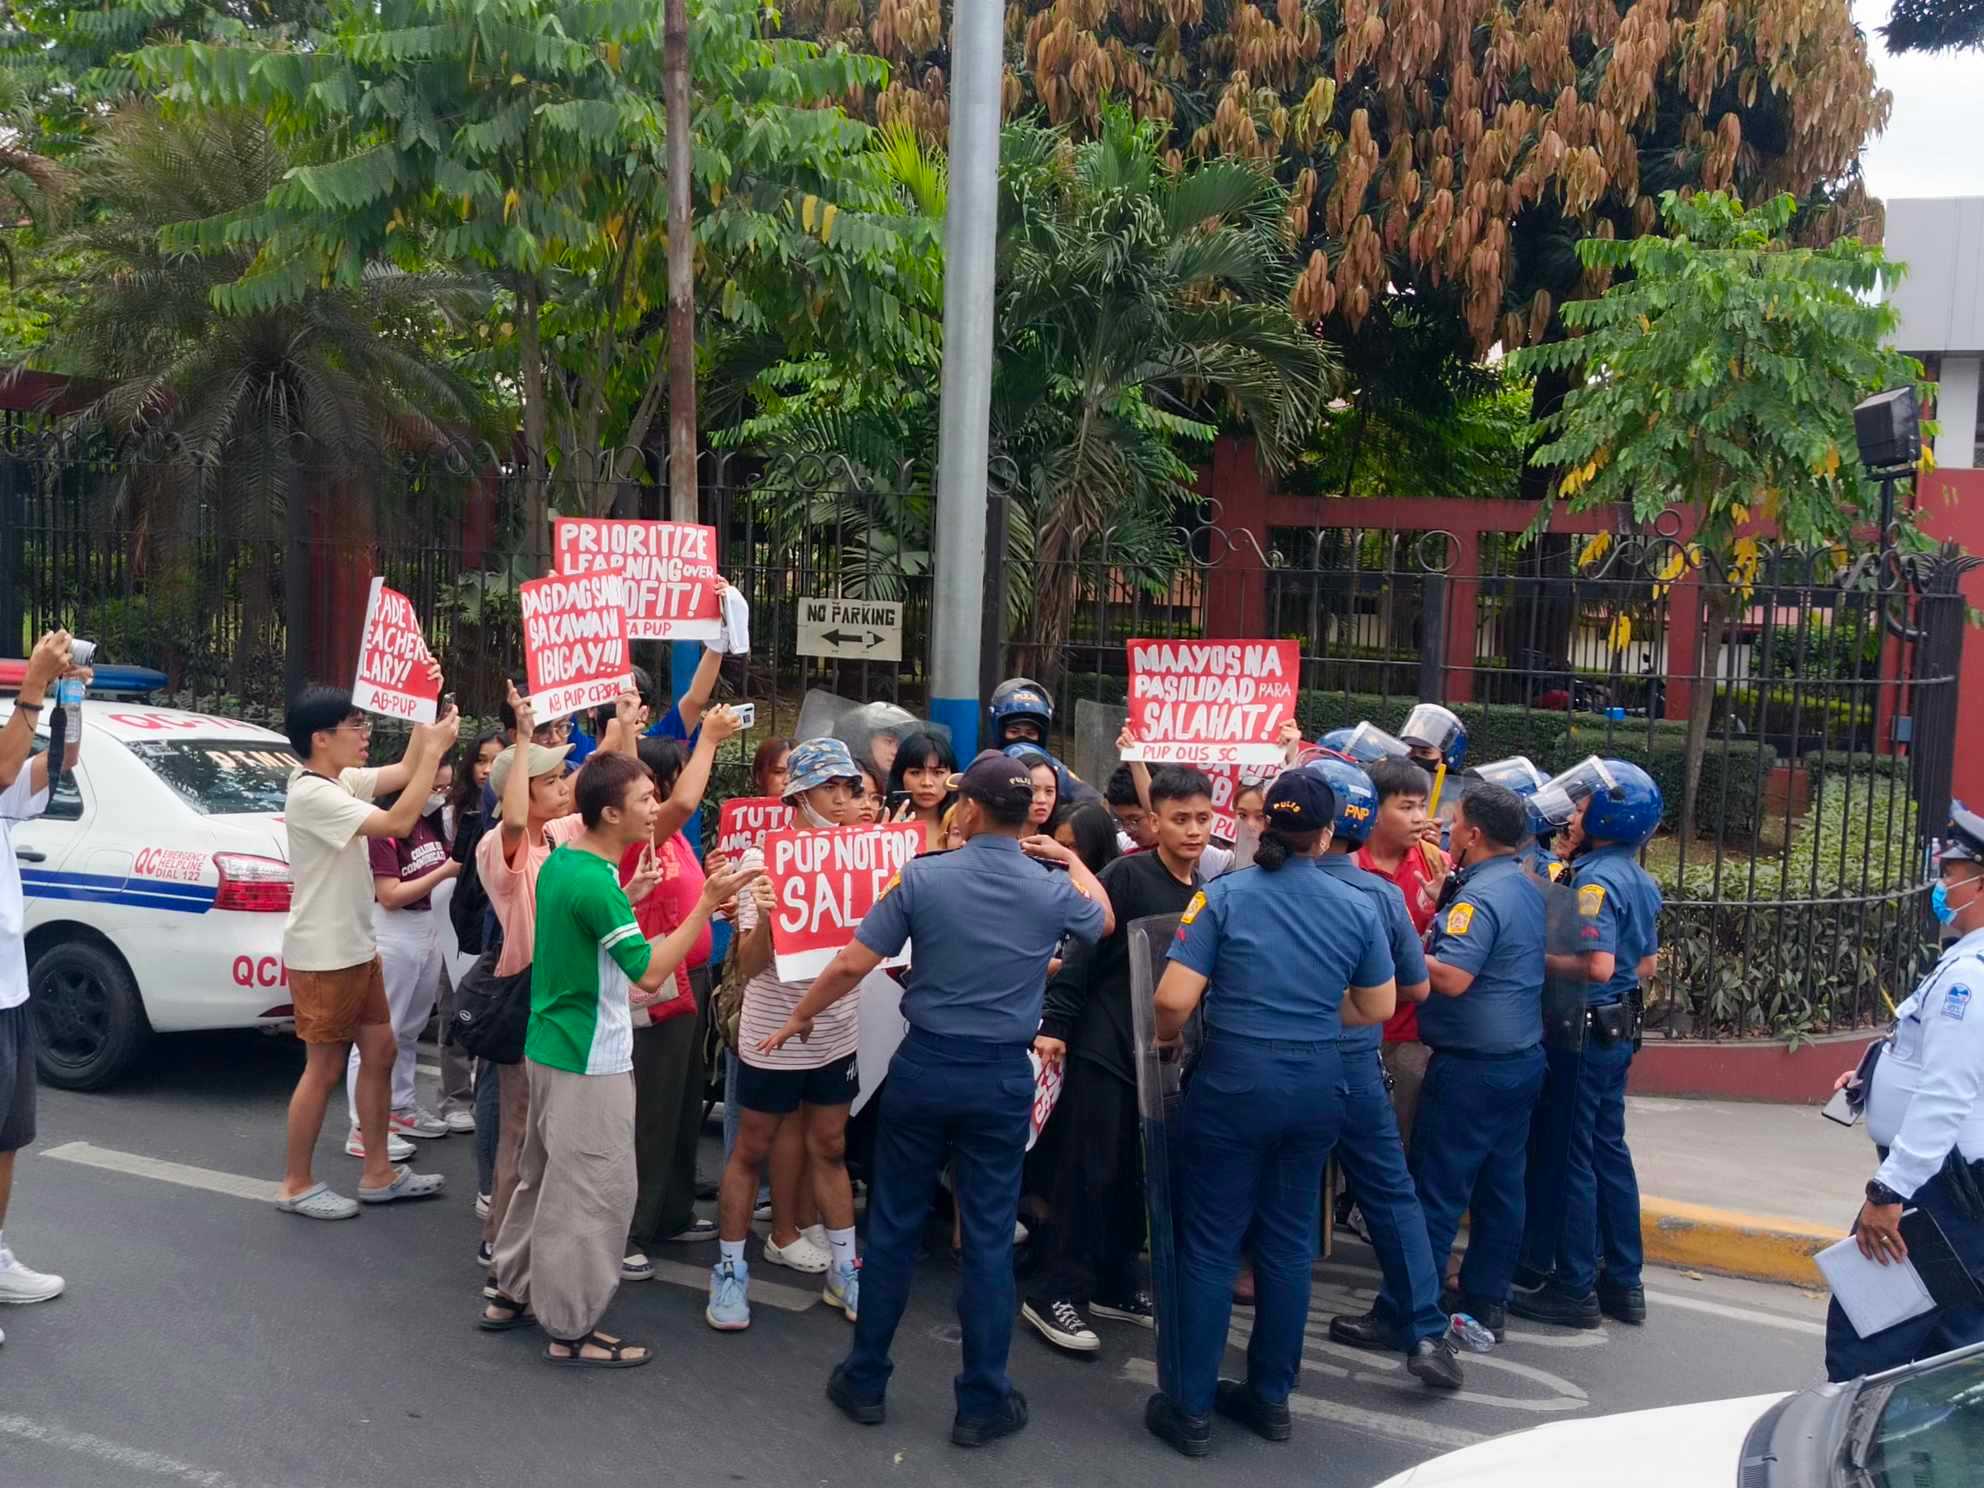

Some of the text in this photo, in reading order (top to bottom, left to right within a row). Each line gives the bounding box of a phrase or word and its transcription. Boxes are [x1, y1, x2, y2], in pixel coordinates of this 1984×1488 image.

[560, 523, 708, 560] PRIORITIZE
[683, 564, 714, 578] OVER
[521, 580, 592, 619] DAGDAG
[808, 604, 895, 626] NO PARKING
[643, 622, 673, 636] PUP
[1134, 644, 1282, 677] MAAYOS NA
[564, 690, 585, 709] PUP
[1134, 676, 1292, 704] PASILIDAD PARA
[1144, 702, 1283, 741] SALAHAT!
[1142, 745, 1238, 761] PUP OUS SC
[1344, 804, 1370, 821] PNP
[134, 848, 162, 876] QC
[775, 837, 830, 875] PUP
[834, 833, 881, 872] NOT
[880, 830, 920, 870] FOR
[156, 868, 201, 881] DIAL 122
[158, 860, 204, 870] HELPLINE
